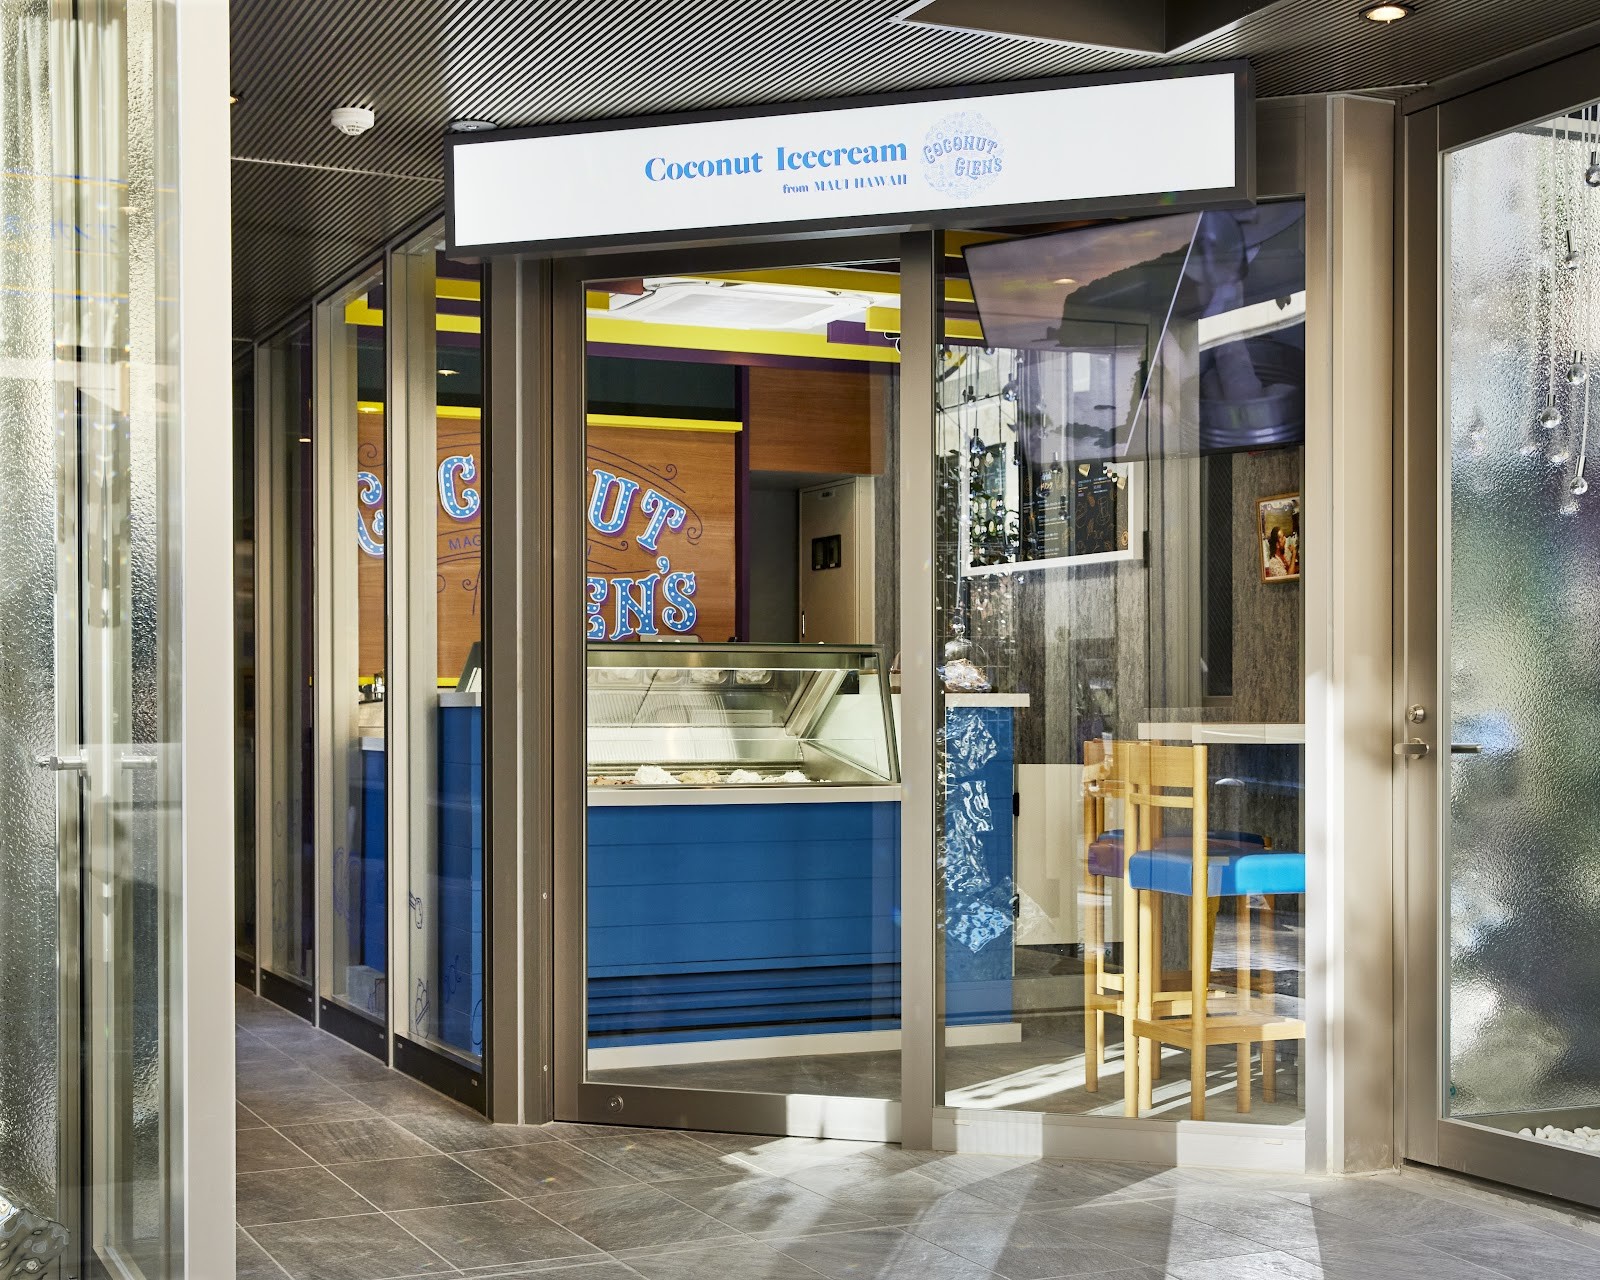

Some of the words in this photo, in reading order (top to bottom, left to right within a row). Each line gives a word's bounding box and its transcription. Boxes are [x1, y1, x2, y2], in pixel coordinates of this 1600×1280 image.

[645, 152, 763, 182] Coconut
[776, 142, 907, 171] Icecream
[923, 135, 998, 164] COCONUT
[782, 183, 809, 194] from
[814, 178, 849, 191] MAUI
